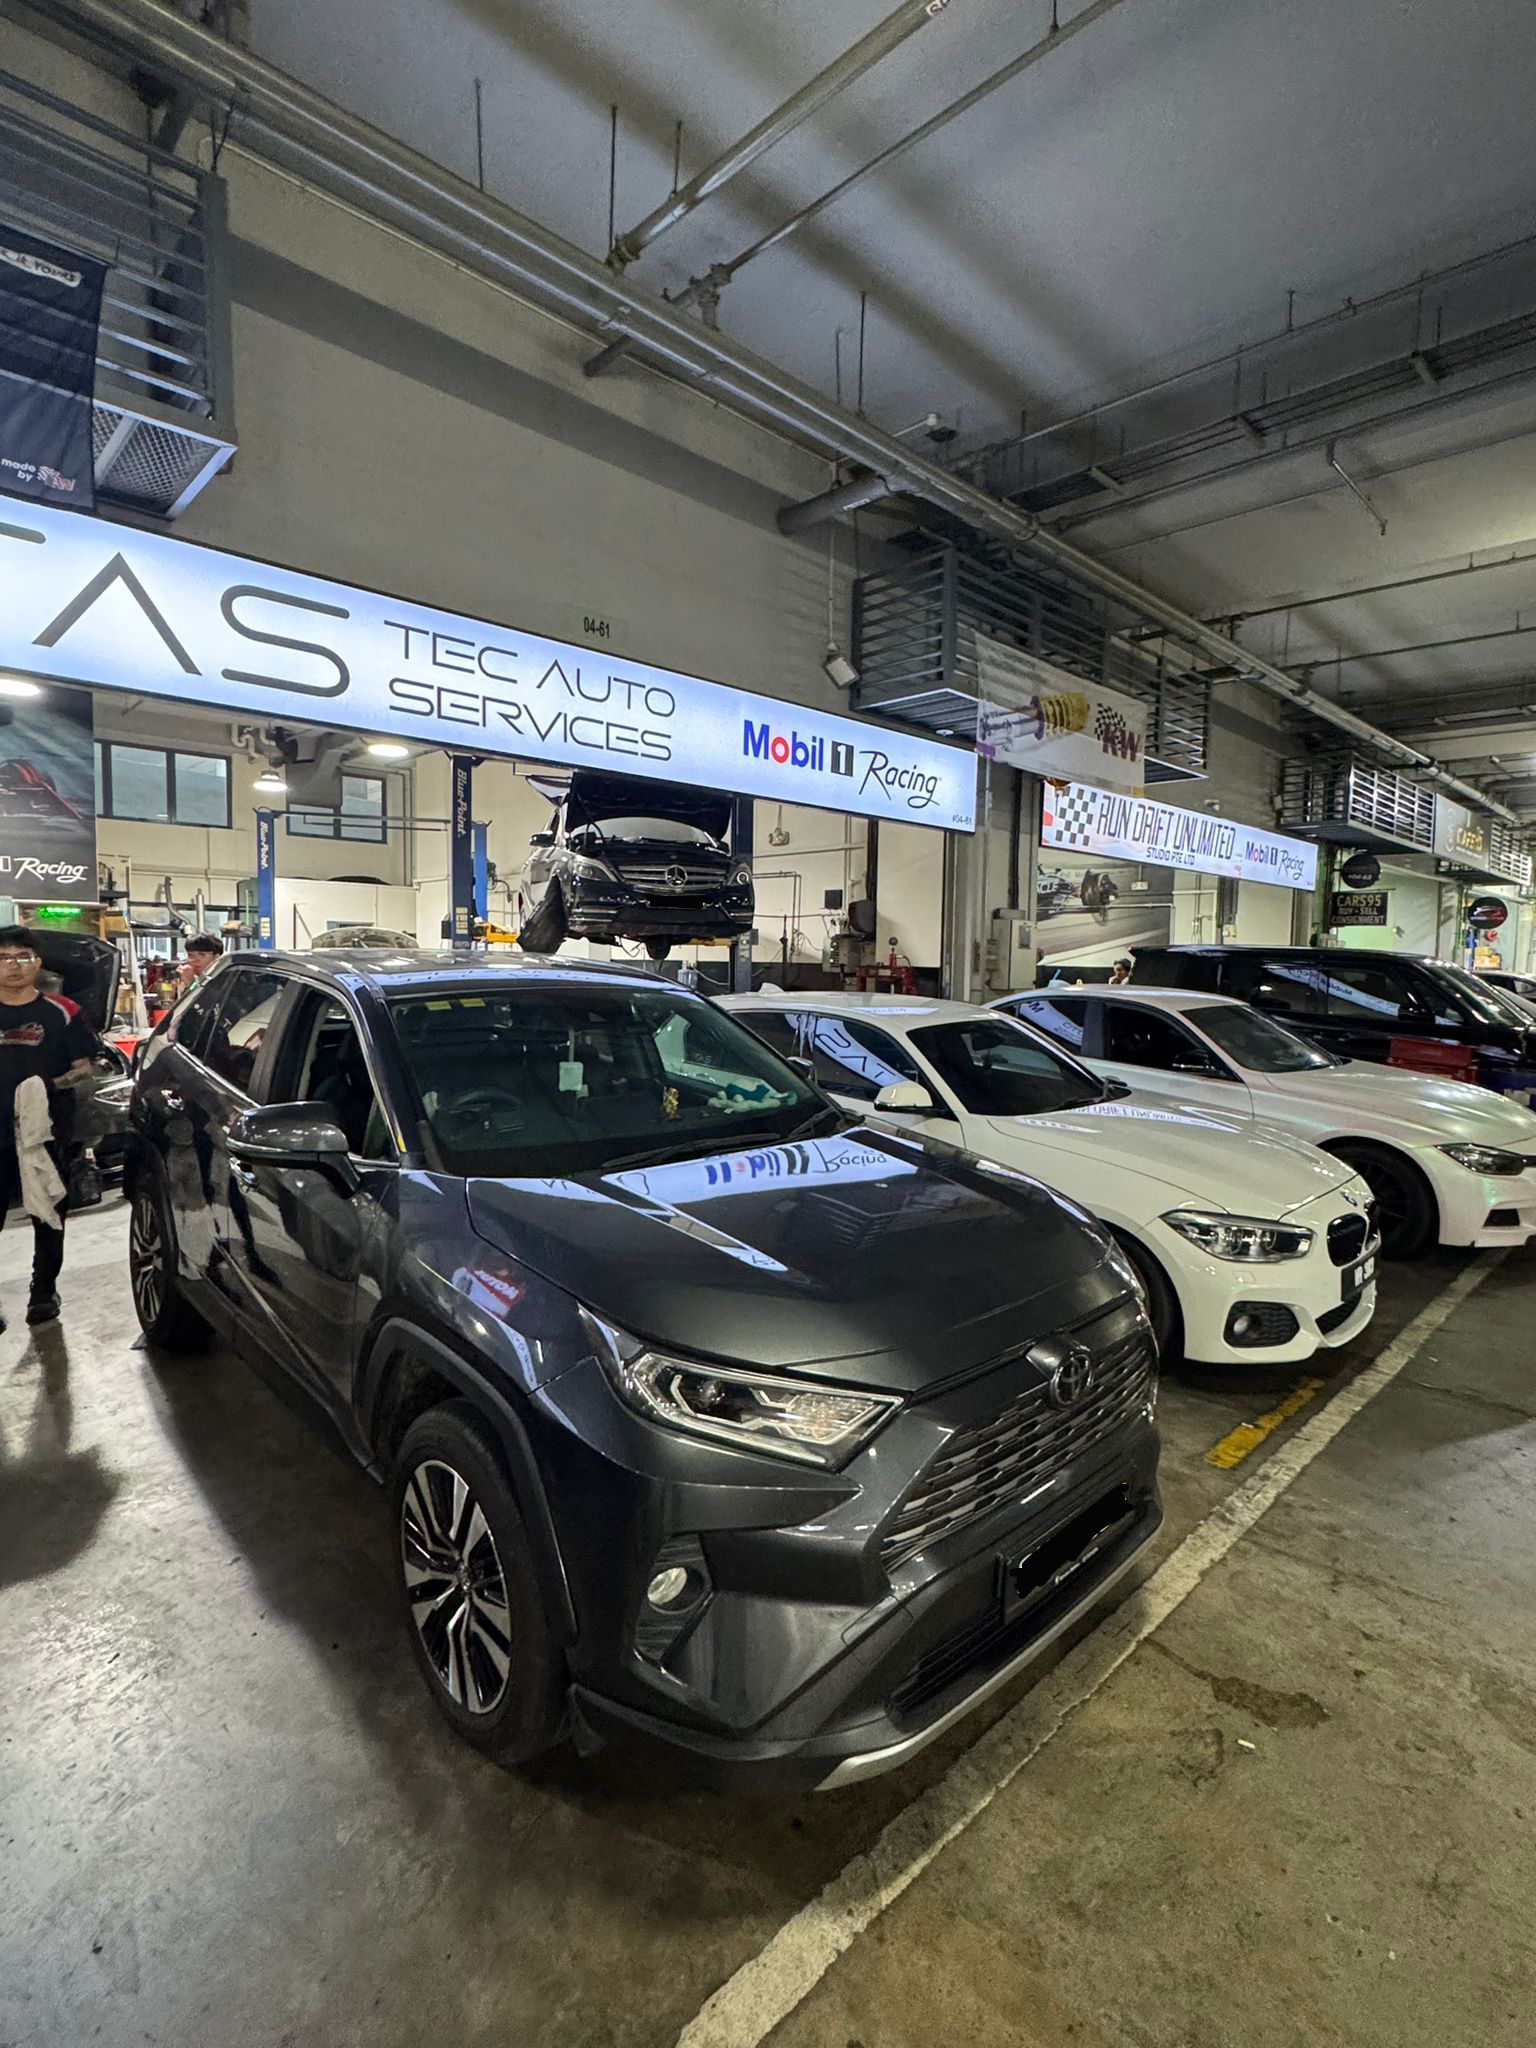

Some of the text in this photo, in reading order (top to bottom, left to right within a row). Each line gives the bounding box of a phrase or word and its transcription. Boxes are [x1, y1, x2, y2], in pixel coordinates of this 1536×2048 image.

[1, 458, 36, 473] made
[17, 470, 33, 483] by
[583, 616, 610, 639] 04-61
[384, 619, 676, 718] TEC AUTO
[389, 677, 672, 761] SERVICES
[1101, 722, 1141, 763] KW
[743, 719, 941, 809] Mobil 1 Racing
[457, 768, 467, 837] Blue-Point
[1096, 794, 1237, 860] RUN DRIFT UNLIMITED
[1146, 846, 1195, 866] STUDIO PTE LTD
[1245, 840, 1269, 864] Mobil
[13, 857, 89, 884] Racing
[1337, 894, 1382, 907] CARS95
